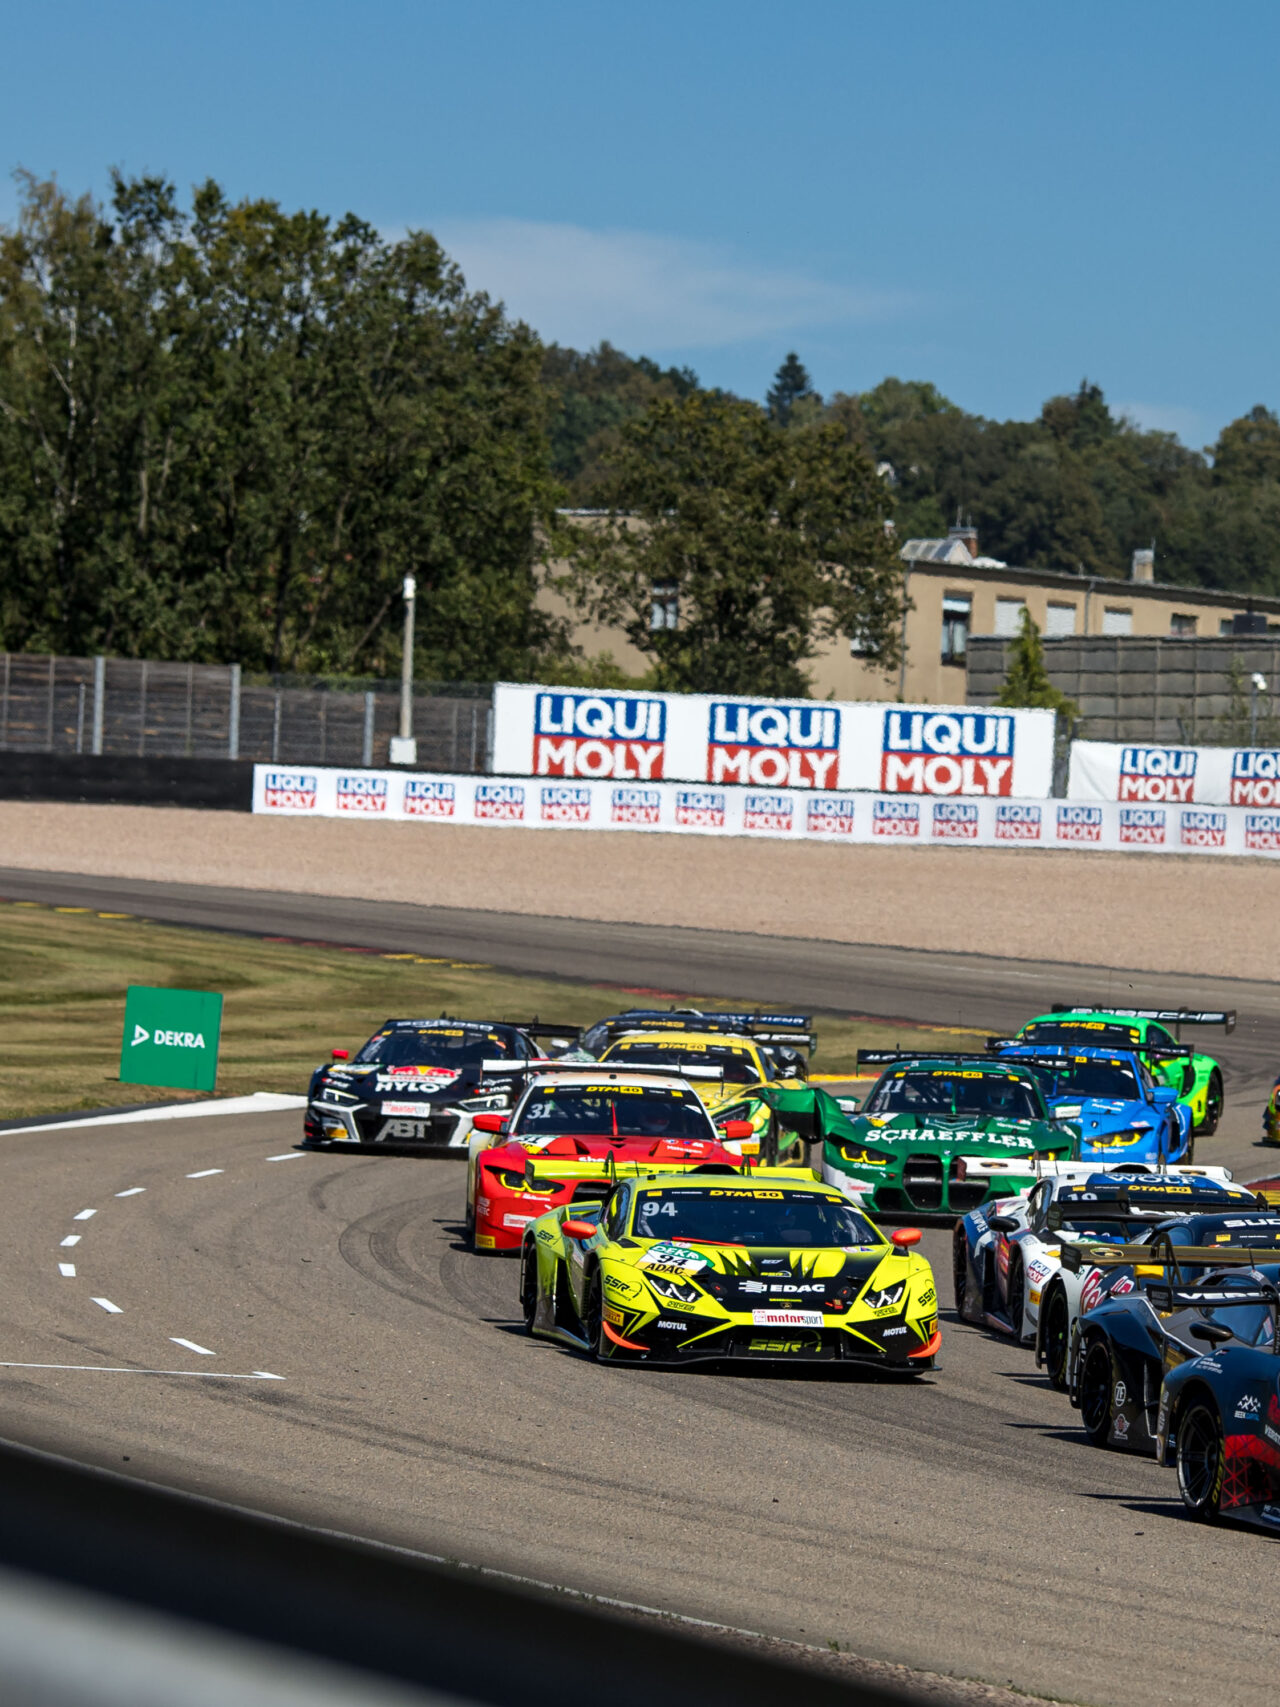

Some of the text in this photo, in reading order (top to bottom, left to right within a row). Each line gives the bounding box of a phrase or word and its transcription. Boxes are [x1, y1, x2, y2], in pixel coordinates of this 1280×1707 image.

[538, 696, 661, 739] LIQUI
[713, 704, 836, 749] LIQUI
[888, 715, 1009, 756] LIQUI
[537, 740, 662, 777] MOLY
[1123, 750, 1195, 775] LIQUI
[712, 749, 836, 787] MOLY
[887, 758, 1010, 794] MOLY
[267, 775, 316, 791] LIQUI
[339, 778, 387, 794] LIQUI
[407, 782, 454, 799] LIQUI
[1122, 776, 1194, 801] MOLY
[266, 790, 315, 807] MOLY
[338, 794, 385, 810] MOLY
[477, 787, 524, 802] LIQUI
[543, 789, 590, 804] LIQUI
[613, 791, 660, 807] LIQUI
[678, 794, 724, 810] LIQUI
[406, 798, 453, 815] MOLY
[477, 802, 523, 819] MOLY
[544, 805, 589, 820] MOLY
[747, 798, 792, 813] LIQUI
[810, 800, 854, 816] LIQUI
[875, 802, 919, 818] LIQUI
[935, 805, 977, 820] LIQUI
[614, 806, 659, 822] MOLY
[678, 808, 724, 825] MOLY
[746, 812, 791, 829] MOLY
[998, 807, 1040, 822] LIQUI
[1058, 808, 1101, 824] LIQUI
[1122, 811, 1164, 826] LIQUI
[1182, 813, 1225, 829] LIQUI
[810, 816, 852, 832] MOLY
[874, 819, 919, 836] MOLY
[935, 821, 977, 837] MOLY
[998, 822, 1039, 839] MOLY
[1059, 824, 1100, 840] MOLY
[1122, 827, 1164, 843] MOLY
[1185, 829, 1224, 845] MOLY
[154, 1030, 205, 1049] DEKRA
[880, 1079, 905, 1094] 11
[527, 1104, 551, 1119] 31
[375, 1119, 432, 1142] ABT
[865, 1128, 1036, 1150] SCHAEFFLER
[709, 1190, 780, 1199] DTM 40
[642, 1202, 678, 1217] 94
[657, 1254, 688, 1267] 94
[1031, 1259, 1051, 1276] LIQUI
[604, 1275, 631, 1292] SSR
[770, 1284, 825, 1293] EDAG
[657, 1320, 688, 1331] MOTUL
[766, 1313, 823, 1326] motorsport
[883, 1326, 908, 1337] MOTUL
